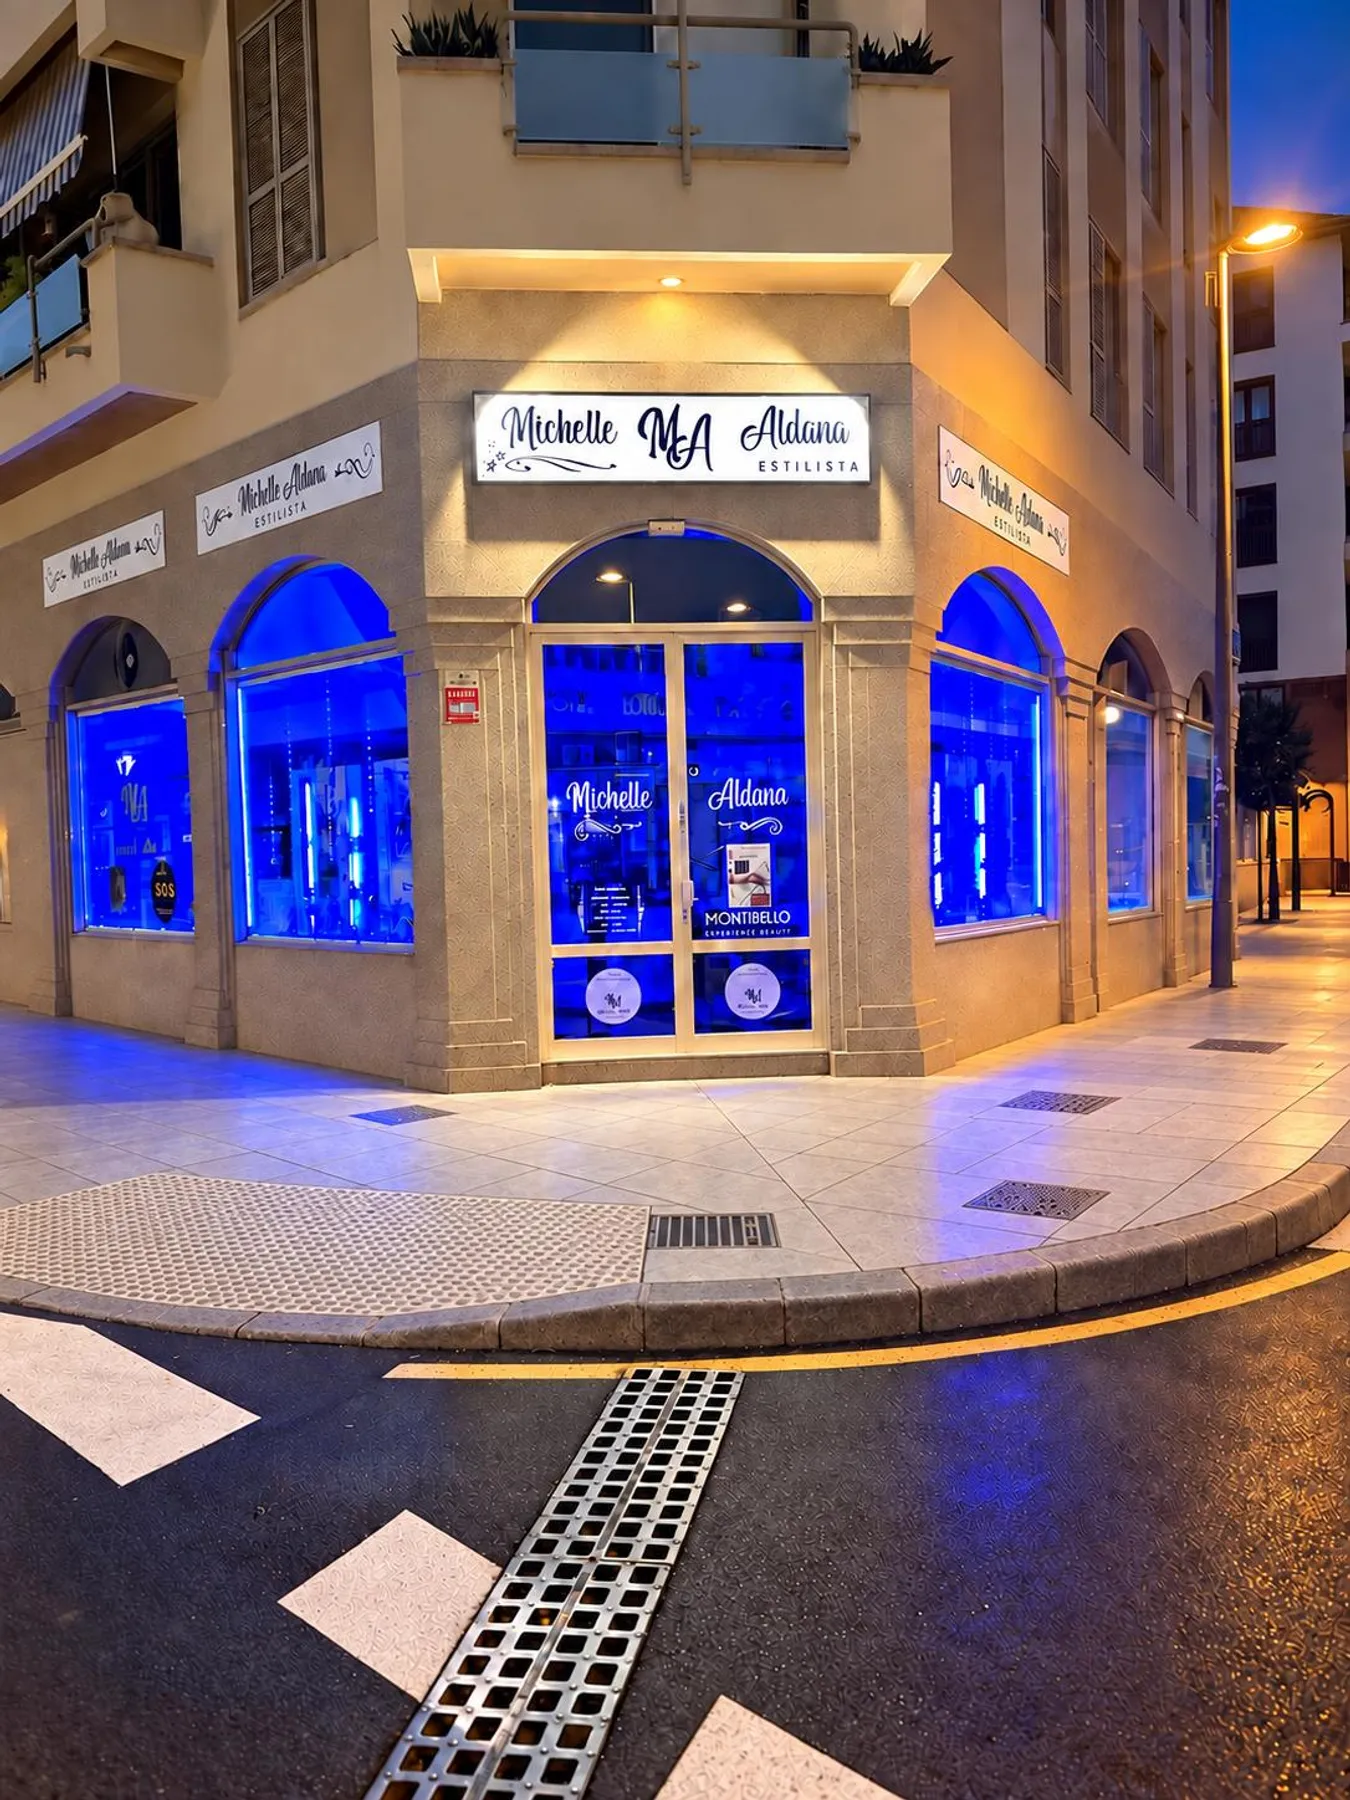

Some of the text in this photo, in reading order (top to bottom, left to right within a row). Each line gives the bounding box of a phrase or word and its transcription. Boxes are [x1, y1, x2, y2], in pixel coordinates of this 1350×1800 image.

[501, 405, 618, 449] Michelle
[740, 405, 850, 452] Aldana
[758, 460, 860, 473] ESTILISTA
[237, 460, 327, 516] Michelle Aldana
[979, 464, 1044, 535] Michelle Aldana
[254, 501, 308, 528] ESTILISTA
[994, 516, 1031, 546] ESTILISTA
[566, 777, 790, 814] Michelle Aldana
[155, 882, 175, 899] SOS
[704, 909, 791, 926] MONTIBELLO
